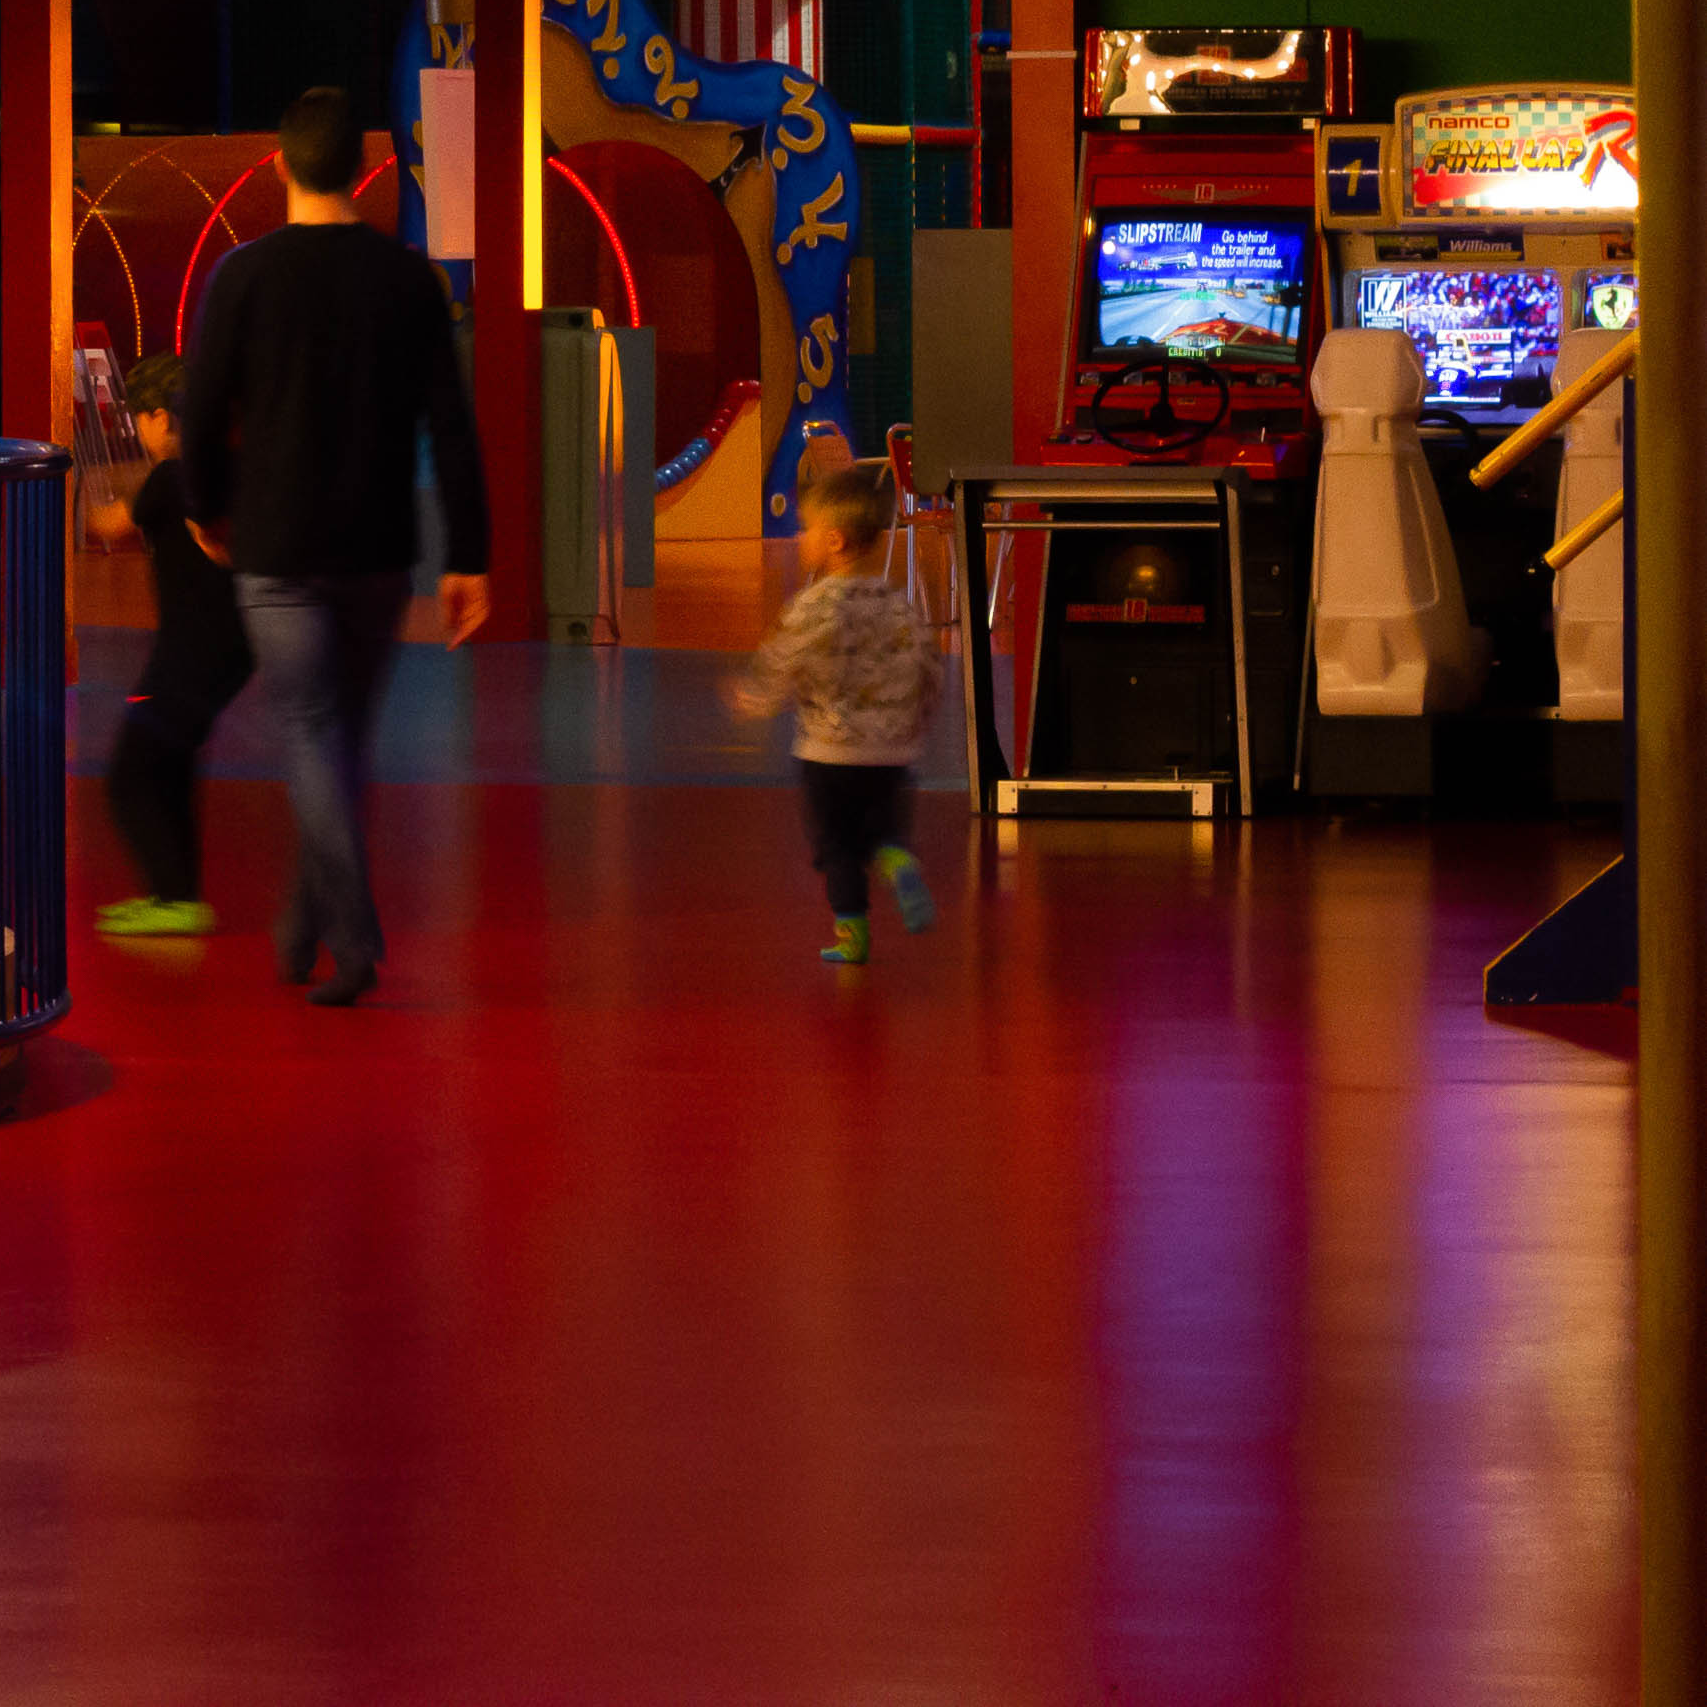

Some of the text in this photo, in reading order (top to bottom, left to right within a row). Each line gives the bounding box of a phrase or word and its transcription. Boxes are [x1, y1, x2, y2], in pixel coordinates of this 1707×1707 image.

[1429, 116, 1510, 129] namco
[1424, 139, 1516, 174] FINAL
[1520, 138, 1587, 172] LAP
[1344, 159, 1362, 197] 1
[1118, 222, 1203, 243] SLIPSTREAM
[1221, 230, 1268, 243] Go behind
[1212, 244, 1276, 255] the trailer and
[1450, 239, 1512, 253] Williams
[1201, 256, 1213, 267] the
[1214, 257, 1235, 269] speed
[1236, 257, 1248, 268] will
